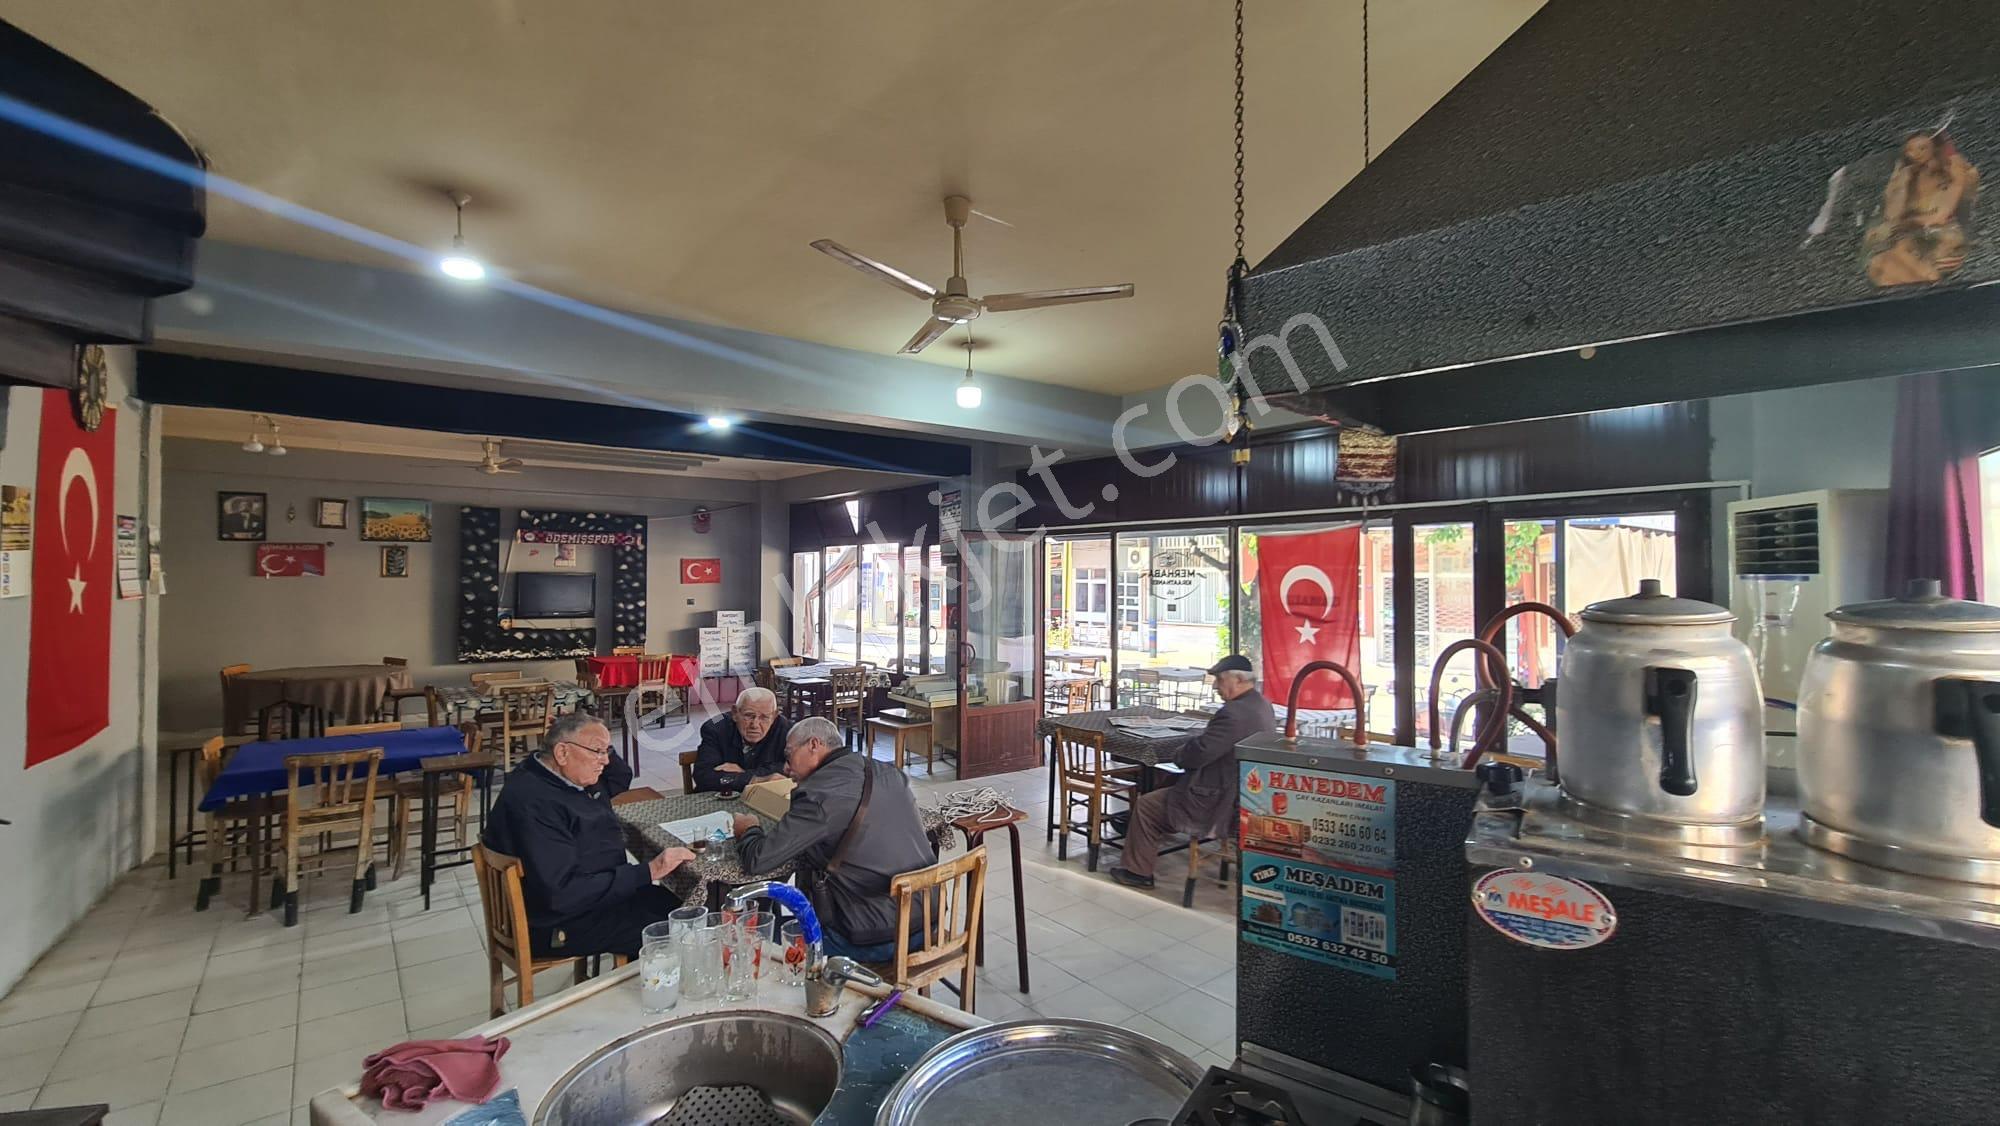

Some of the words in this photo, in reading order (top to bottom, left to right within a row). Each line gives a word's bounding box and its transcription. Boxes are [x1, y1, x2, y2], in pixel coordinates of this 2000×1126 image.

[1268, 771, 1387, 803] HANEDEM
[1311, 835, 1337, 849] 0232
[1312, 818, 1336, 834] 0533
[1339, 821, 1357, 838] 416
[1358, 825, 1372, 841] 60
[1284, 866, 1385, 899] MEŞADEM
[1508, 891, 1595, 921] MEŞALE
[1287, 932, 1319, 948] 0532
[1322, 940, 1347, 955] 632
[1350, 946, 1367, 960] 42
[1371, 953, 1389, 965] 50
